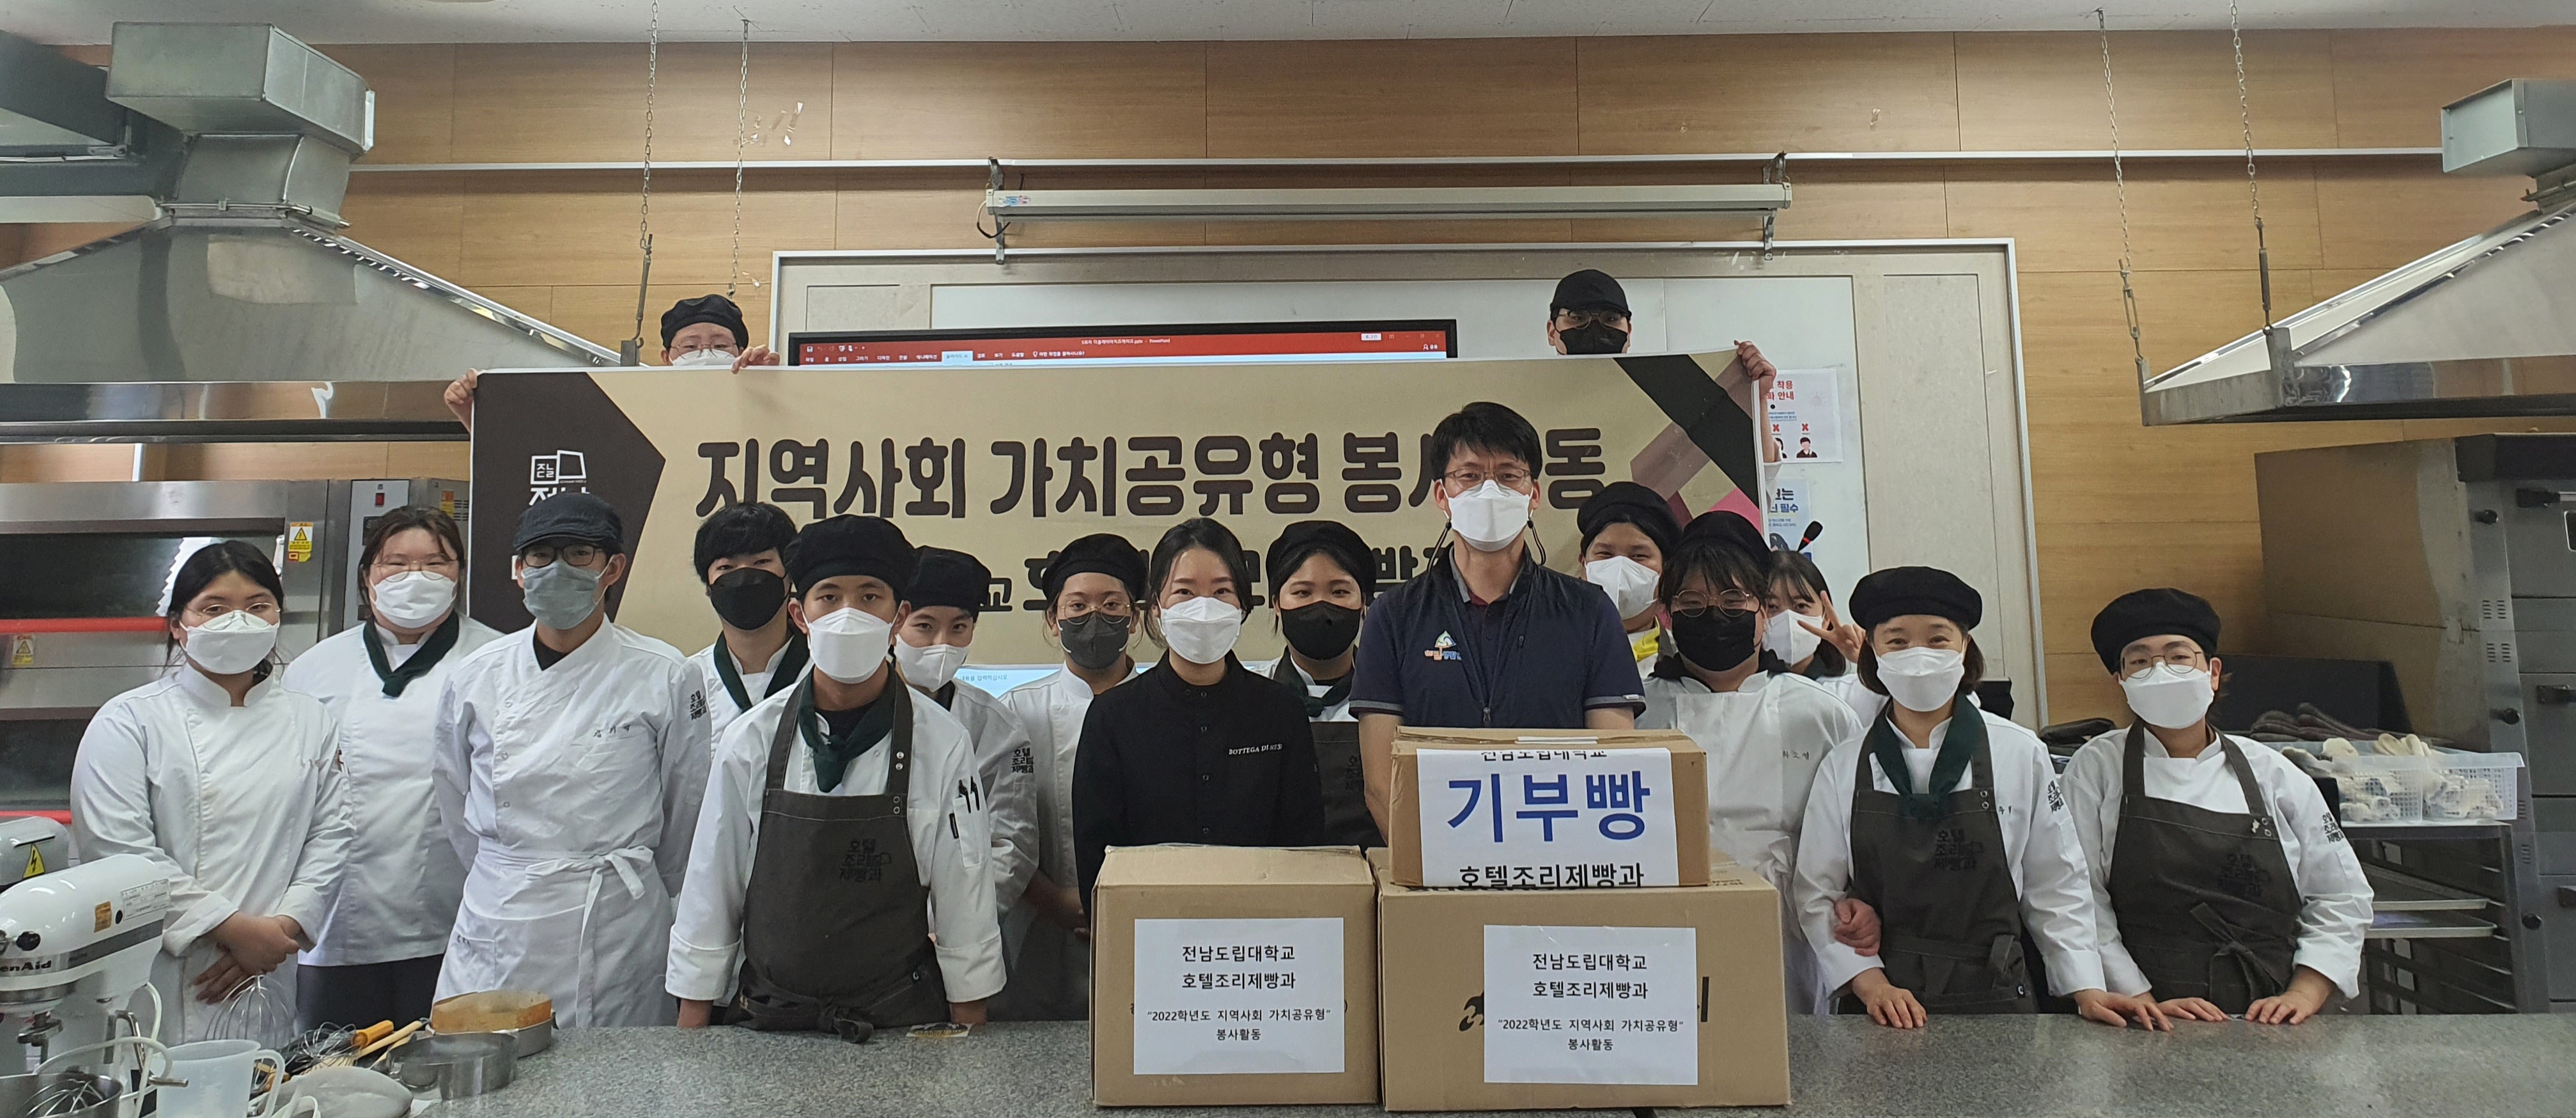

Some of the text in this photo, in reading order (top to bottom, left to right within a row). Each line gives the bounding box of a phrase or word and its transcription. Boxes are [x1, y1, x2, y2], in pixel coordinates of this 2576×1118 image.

[1778, 391, 1794, 400] 안내
[696, 437, 966, 520] 지역사회
[990, 431, 1321, 518] 가치공유형
[1229, 747, 1260, 755] BOTTEGA
[1447, 770, 1651, 843] 기부빵
[1459, 862, 1645, 887] 호텔조리제빵과
[1182, 945, 1296, 962] 전남도립대학교
[1532, 953, 1648, 972] 전남도립대학교
[1182, 972, 1296, 990] 호텔조리제빵과
[1532, 981, 1649, 999] 호텔조리제빵과
[1217, 1009, 1262, 1021] 지역사회
[1569, 1018, 1615, 1032] 지역사회
[1216, 1028, 1262, 1041] 봉사활동
[1567, 1037, 1614, 1052] 봉사활동
